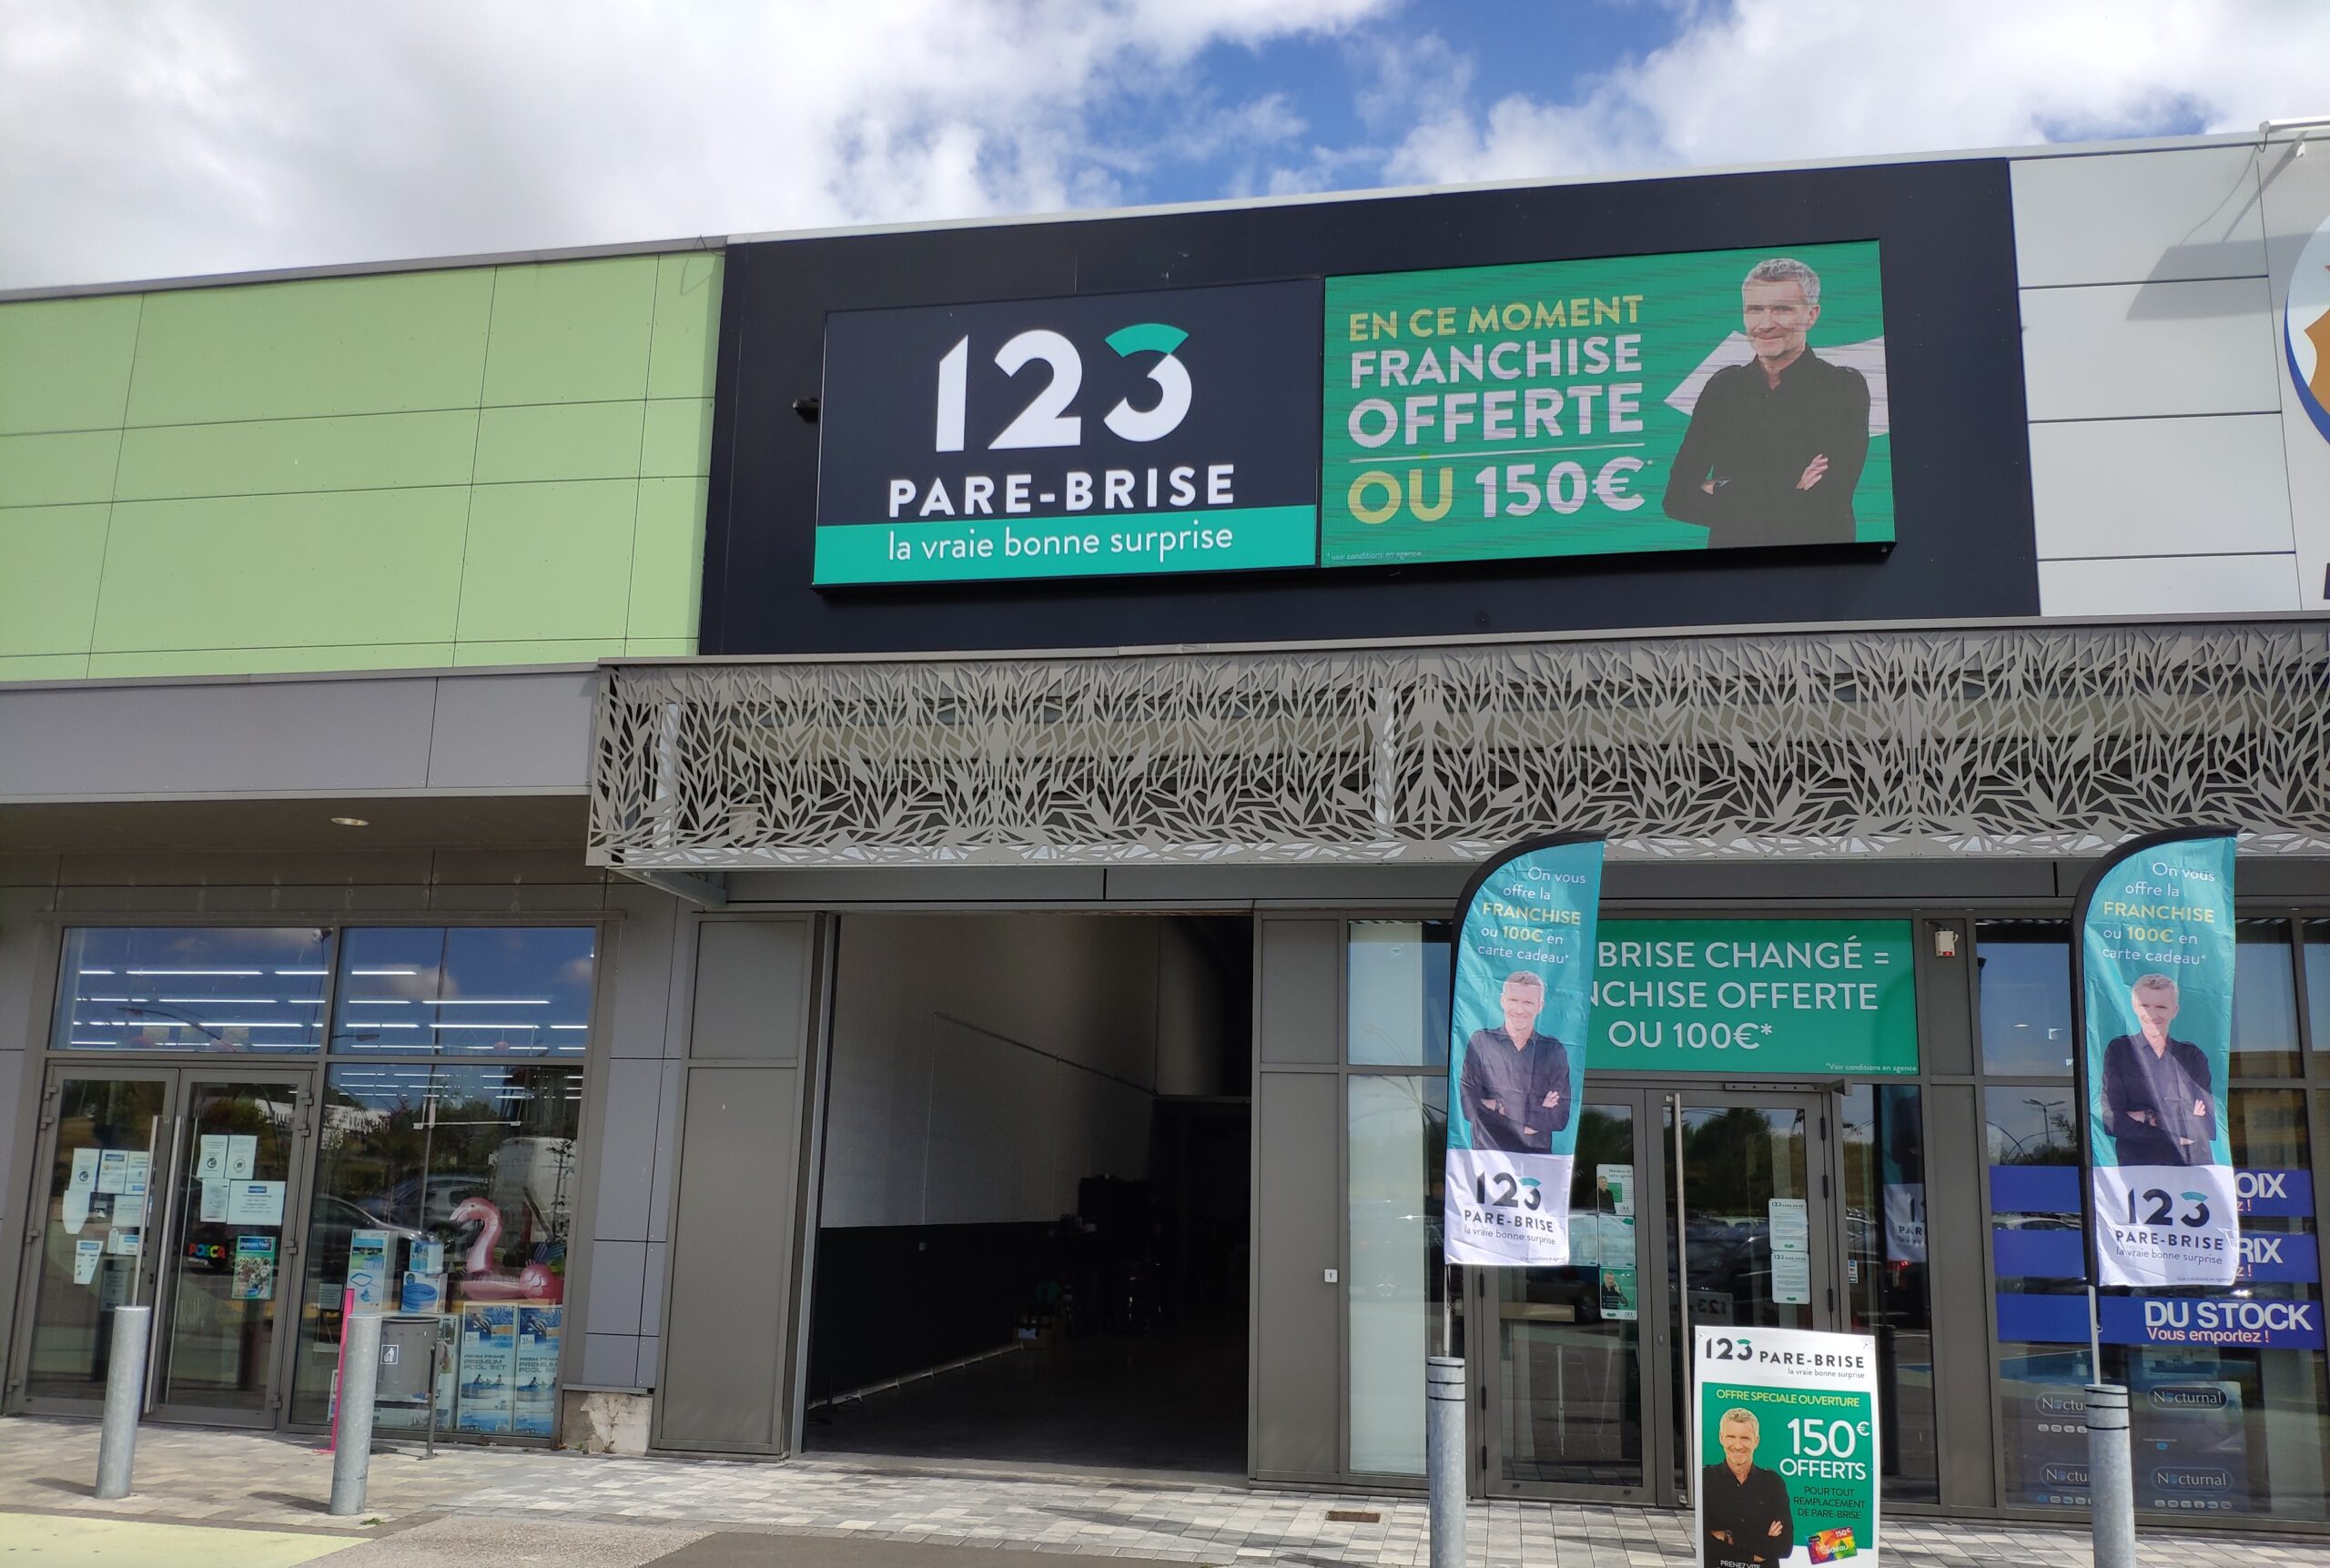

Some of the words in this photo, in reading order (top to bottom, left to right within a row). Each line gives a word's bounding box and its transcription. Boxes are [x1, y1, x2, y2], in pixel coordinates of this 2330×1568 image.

[1349, 312, 1398, 341] EN
[1409, 309, 1457, 338] CE
[1467, 294, 1645, 334] MOMENT
[1351, 334, 1643, 389] FRANCHISE
[936, 323, 1192, 452] 123
[1348, 382, 1645, 449] OFFERTE
[888, 464, 1234, 518] PARE-BRISE
[1347, 468, 1454, 525] OU
[888, 531, 911, 561] la
[921, 528, 993, 560] vraie
[1005, 527, 1100, 557] bonne
[1110, 520, 1233, 563] surprise
[1528, 866, 1550, 881] On
[1555, 873, 1586, 884] vous
[2152, 862, 2178, 877] On
[2182, 868, 2215, 882] vous
[1503, 884, 1535, 899] offre
[1540, 886, 1551, 900] la
[2125, 881, 2163, 896] offre
[2167, 883, 2180, 897] la
[1483, 902, 1581, 926] FRANCHISE
[2103, 901, 2214, 923] FRANCHISE
[1481, 926, 1497, 937] ou
[1503, 926, 1543, 942] 100€
[1546, 935, 1564, 945] en
[2102, 929, 2122, 939] ou
[2127, 926, 2174, 943] 100€
[2179, 934, 2198, 945] en
[1477, 945, 1513, 958] carte
[1598, 940, 1695, 968] BRISE
[1705, 935, 1863, 970] CHANGÉ
[2102, 946, 2141, 960] carte
[1717, 981, 1879, 1011] OFFERTE
[1608, 1020, 1662, 1047] OU
[1845, 1063, 1880, 1071] conditions
[1892, 1066, 1917, 1074] agence
[1476, 1170, 1542, 1210] 123
[2235, 1172, 2287, 1199] OIX
[2128, 1188, 2210, 1228] 123
[1464, 1209, 1554, 1233] PARE-BRISE
[1464, 1224, 1471, 1234] la
[1473, 1226, 1494, 1238] vraie
[1495, 1229, 1525, 1241] bonne
[1526, 1234, 1555, 1246] surprise
[2115, 1229, 2224, 1250] PARE-BRISE
[2116, 1246, 2124, 1256] la
[2126, 1248, 2149, 1258] vraie
[2152, 1249, 2181, 1260] bonne
[2183, 1253, 2223, 1265] surprise
[2238, 1238, 2284, 1264] RIX
[2144, 1300, 2189, 1328] DU
[2196, 1301, 2314, 1330] STOCK
[2146, 1327, 2186, 1340] Vous
[2189, 1329, 2262, 1344] emportez
[1706, 1337, 1753, 1361] 123
[1759, 1351, 1865, 1369] PARE-BRISE
[1788, 1367, 1794, 1375] la
[1795, 1368, 1813, 1376] vraie
[1814, 1369, 1836, 1378] bonne
[1838, 1371, 1865, 1380] surprise
[1716, 1389, 1750, 1401] OFFRE
[1750, 1391, 1798, 1404] SPECIALE
[1799, 1394, 1860, 1408] OUVERTURE
[2042, 1397, 2087, 1411] Noctu
[2153, 1390, 2223, 1404] Nocturnal
[1787, 1417, 1870, 1458] 150€
[1779, 1458, 1867, 1481] OFFERTS
[2046, 1468, 2091, 1482] Noctu
[2157, 1472, 2226, 1486] Nocturnal
[1793, 1496, 1865, 1509] REMPLACEMENT
[1804, 1486, 1829, 1497] POUR
[1830, 1487, 1855, 1497] TOUT
[1798, 1508, 1809, 1517] DE
[1810, 1508, 1861, 1520] PARE-BRISE
